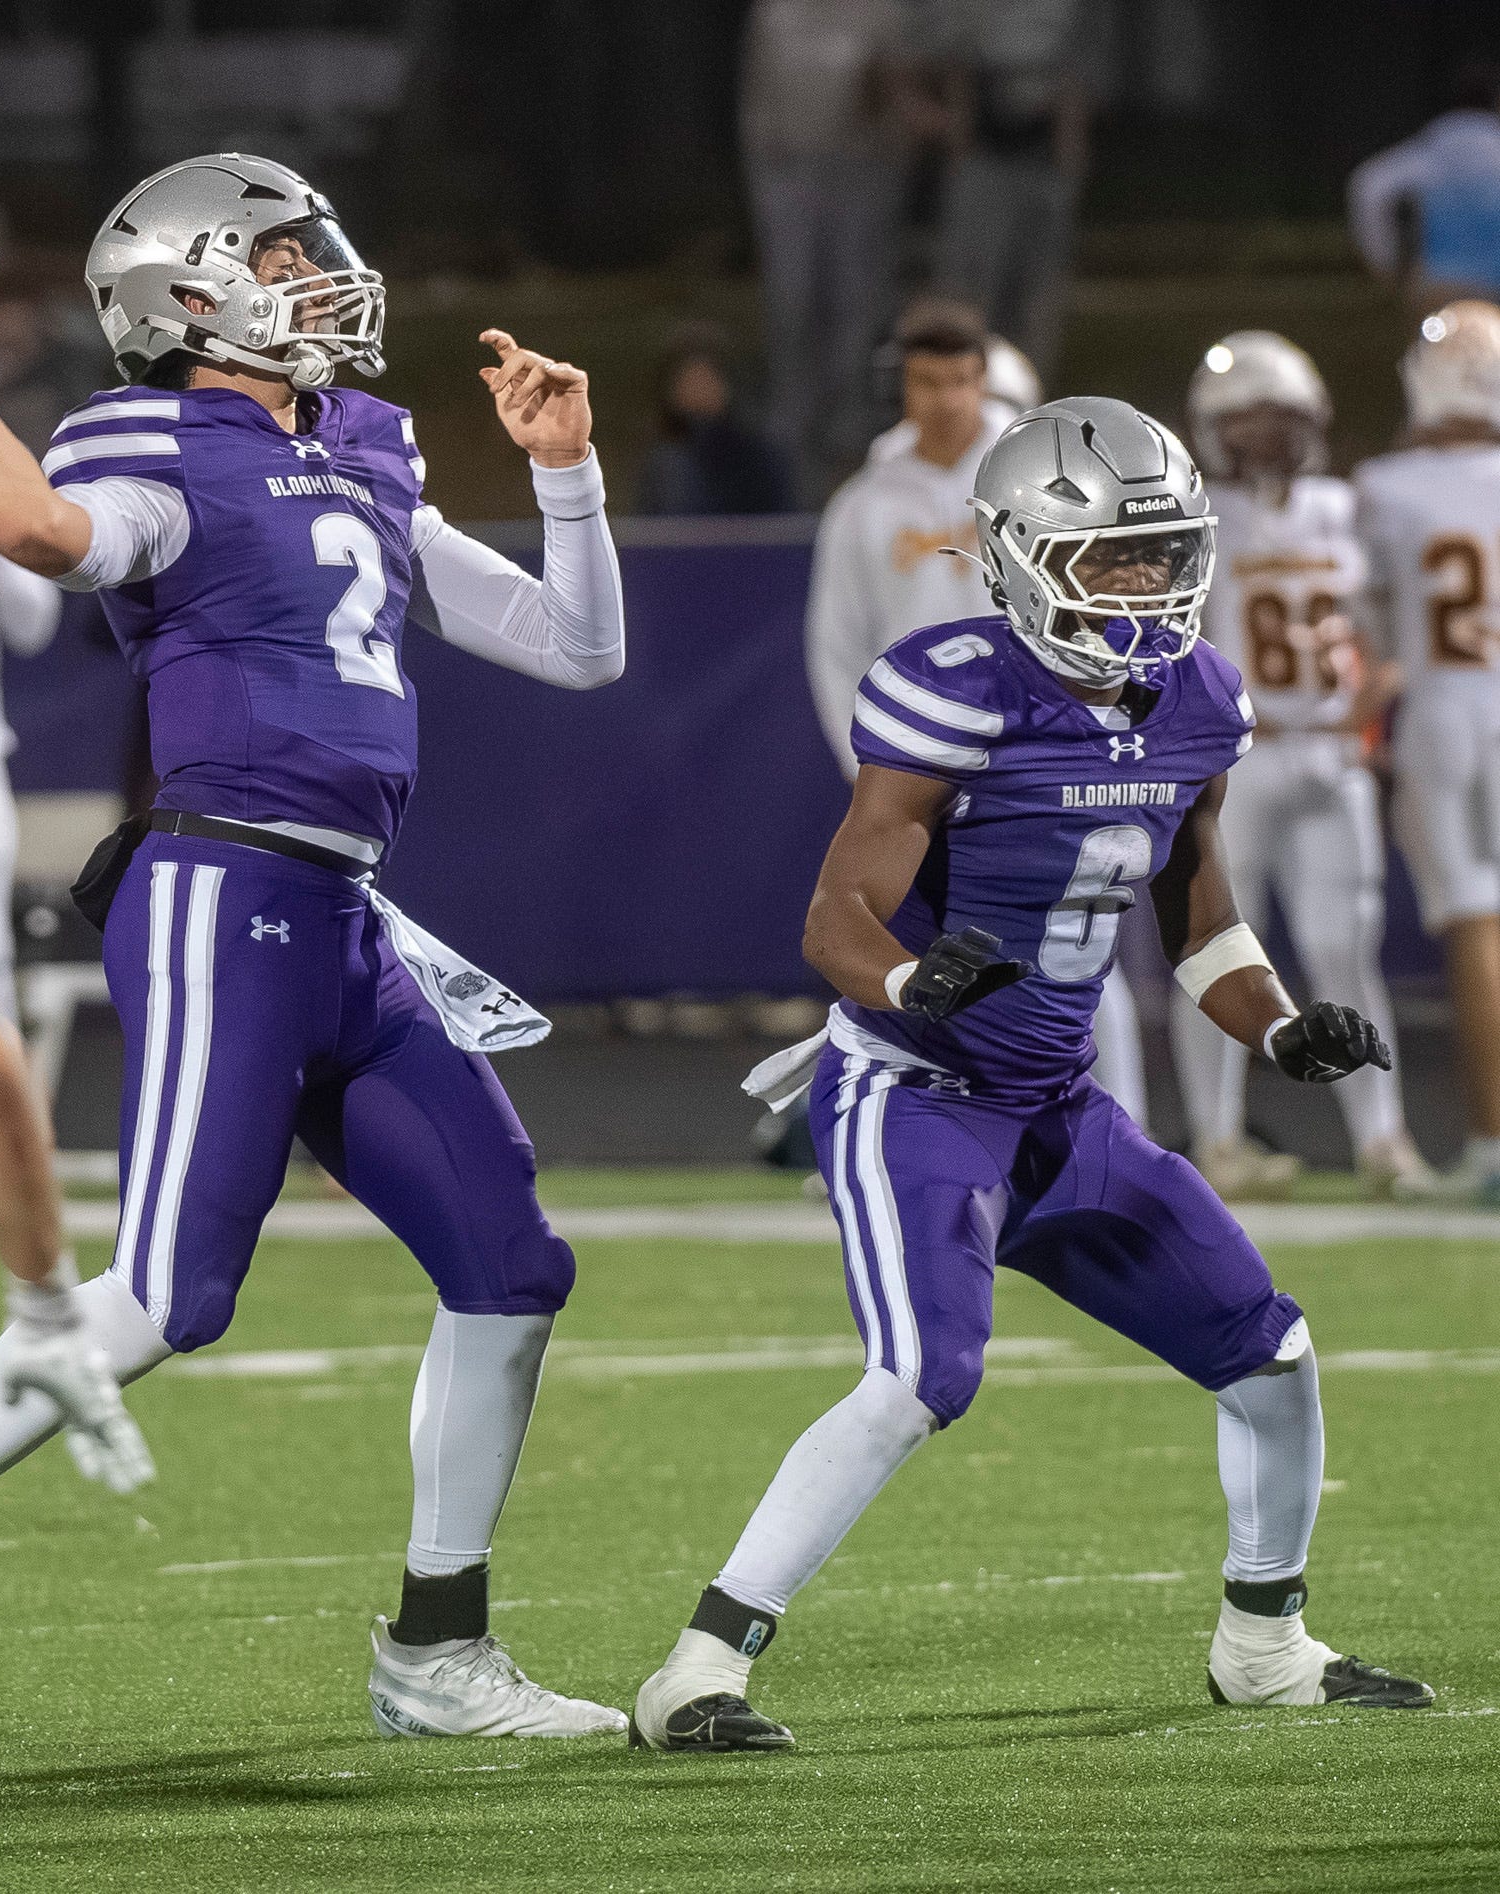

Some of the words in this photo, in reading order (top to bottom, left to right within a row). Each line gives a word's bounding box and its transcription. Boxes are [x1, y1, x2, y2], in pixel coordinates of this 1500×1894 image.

[266, 475, 374, 505] BLOOMINGTON
[1126, 496, 1176, 514] Riddell
[311, 512, 405, 699] 2
[926, 633, 994, 668] 6
[1062, 783, 1176, 808] BLOOMINGTON
[1038, 824, 1152, 983] 6
